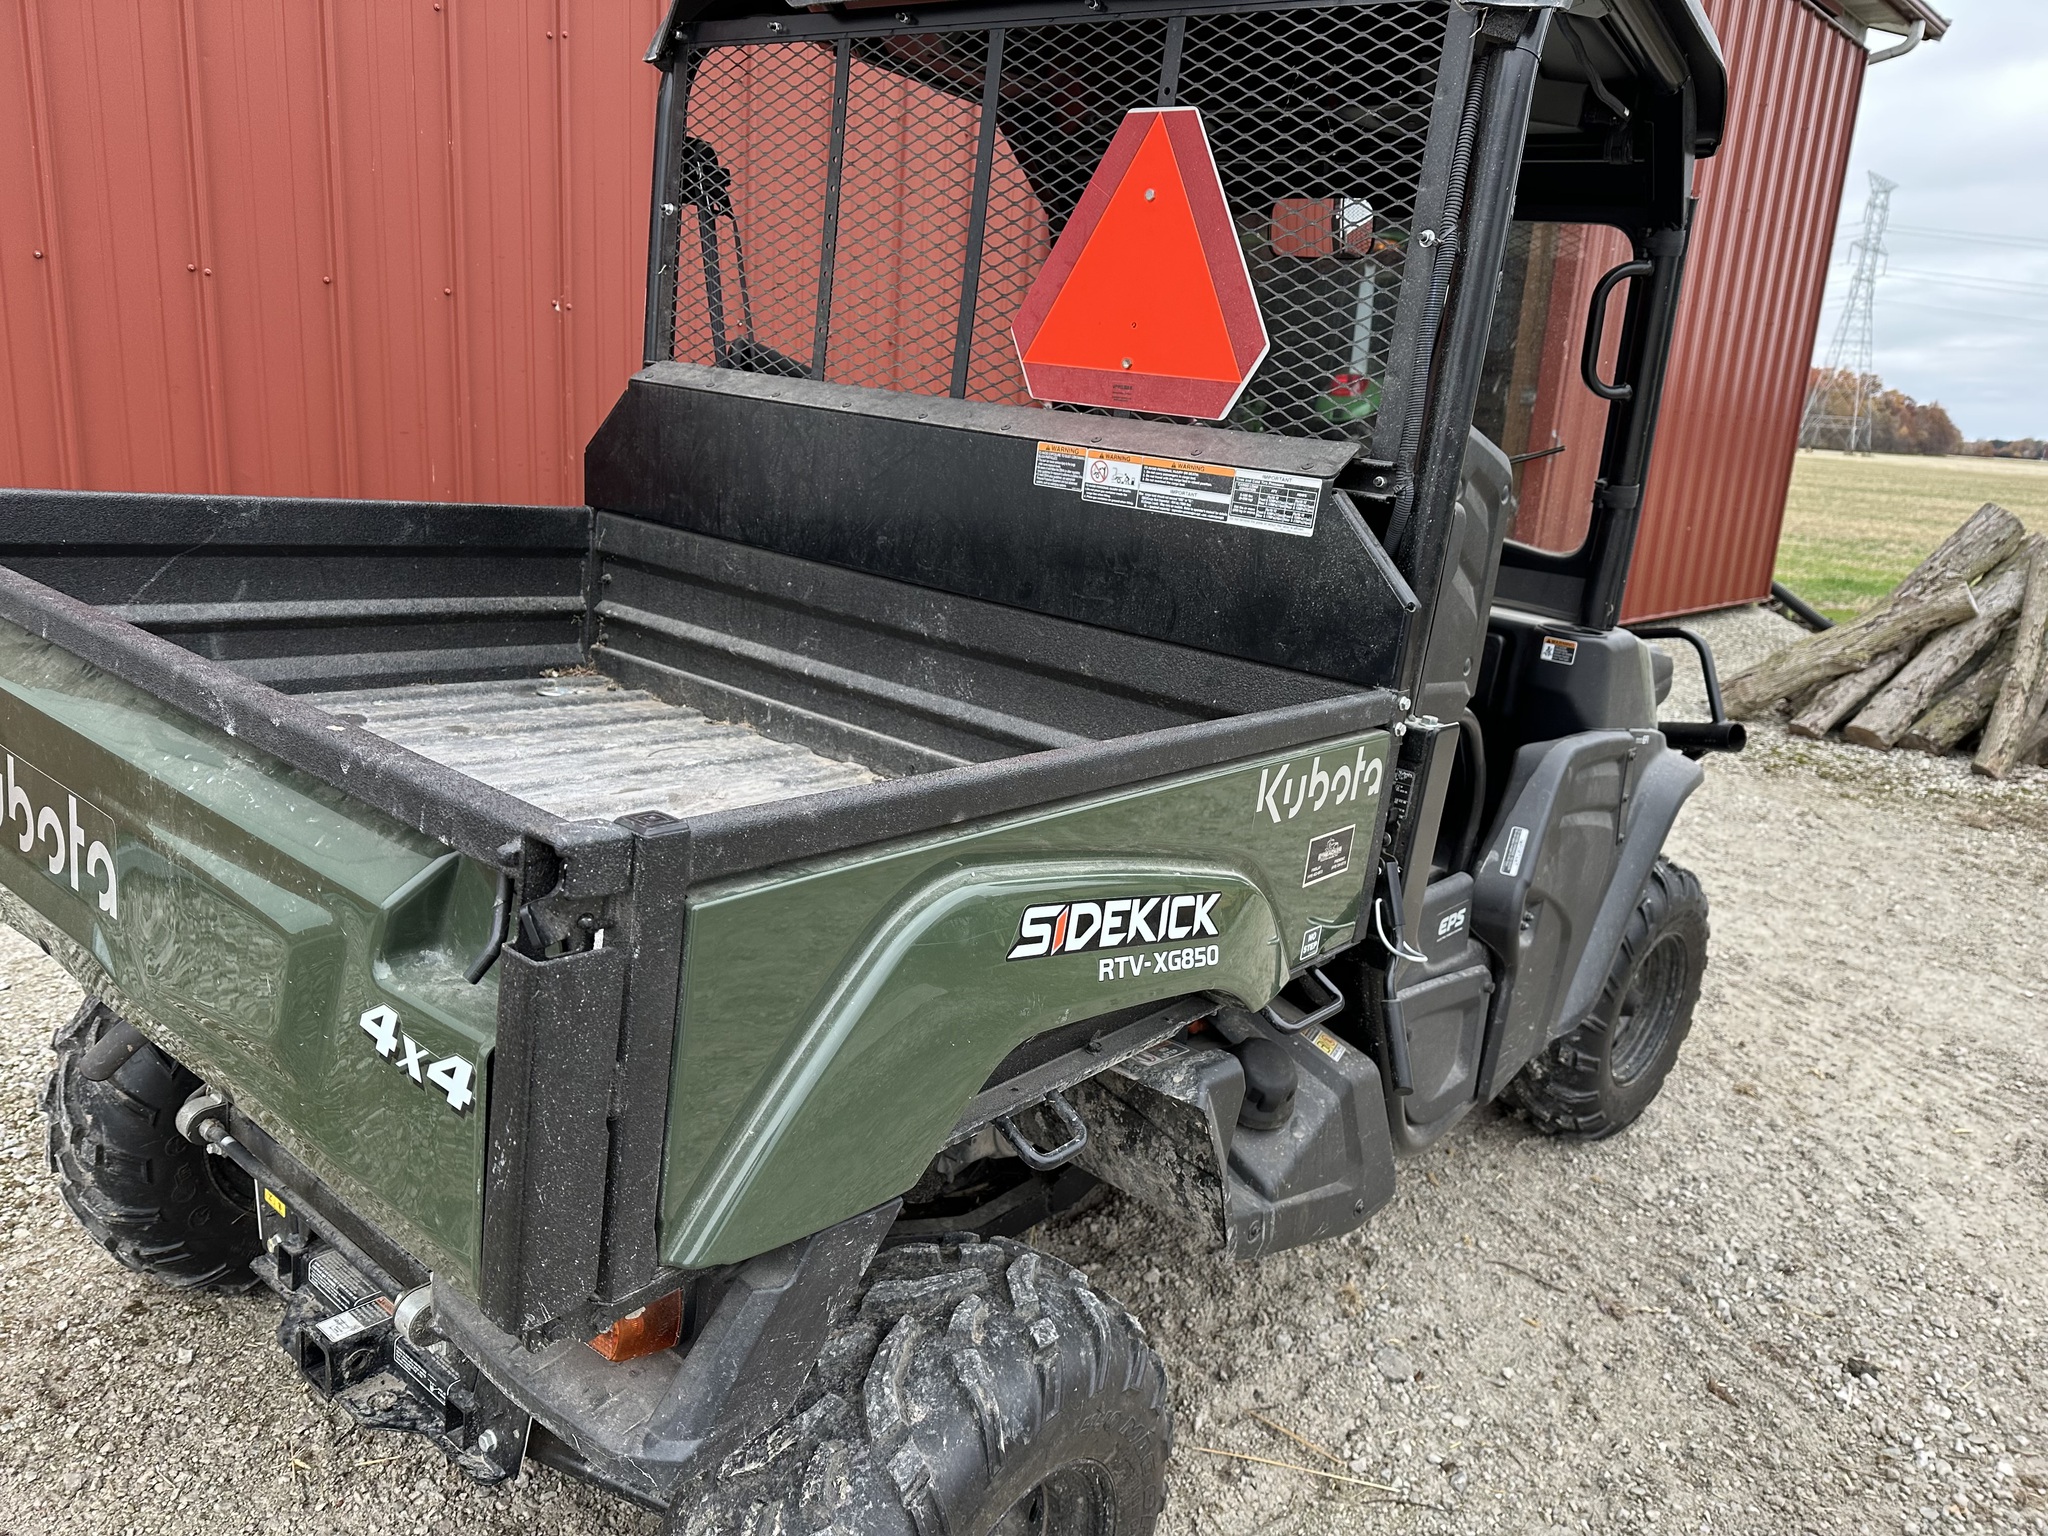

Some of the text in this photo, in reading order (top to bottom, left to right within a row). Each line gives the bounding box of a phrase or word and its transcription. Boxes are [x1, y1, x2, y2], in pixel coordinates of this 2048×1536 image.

[1051, 444, 1080, 455] WARNING
[1105, 453, 1131, 462] WARNING
[1177, 463, 1205, 472] WARNING
[1261, 474, 1293, 483] IMPORTANT
[1256, 747, 1382, 823] Kubota
[0, 754, 118, 920] bota
[1007, 893, 1221, 961] SIDEKICK
[1437, 907, 1467, 936] EPS
[1308, 931, 1317, 943] NO
[1303, 940, 1318, 954] STEP
[1099, 944, 1220, 982] RTV-XG850
